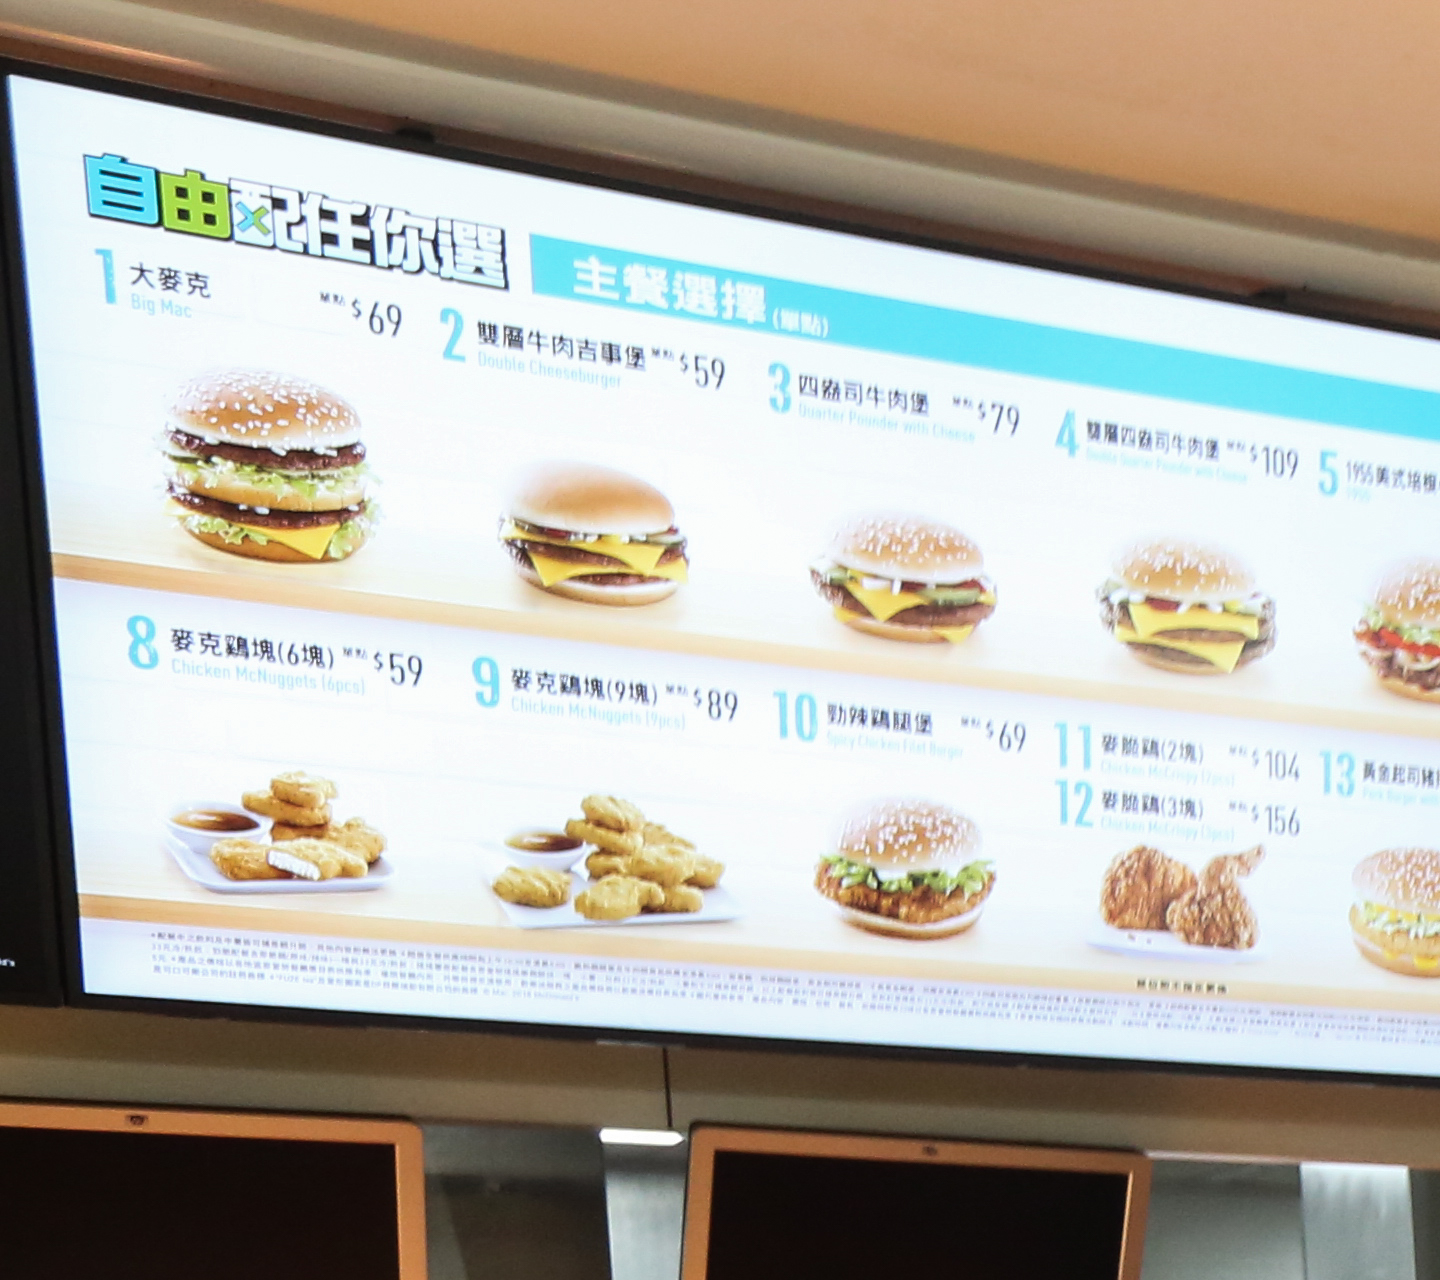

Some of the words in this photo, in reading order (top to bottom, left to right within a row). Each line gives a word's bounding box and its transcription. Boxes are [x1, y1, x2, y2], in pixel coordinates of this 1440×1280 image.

[95, 248, 117, 305] 1
[129, 262, 212, 300] 大麥克
[352, 298, 403, 340] $69
[130, 293, 157, 317] Big
[161, 299, 192, 319] Mac
[573, 255, 765, 325] 主餐選擇
[440, 307, 466, 363] 2
[477, 321, 646, 371] 雙層牛肉吉事堡
[680, 355, 726, 391] $59
[477, 351, 525, 375] Double
[529, 358, 622, 389] Cheeseburger
[768, 362, 791, 414] 3
[978, 402, 1020, 437] $79
[1055, 408, 1079, 458] 4
[1250, 444, 1298, 480] $109
[1319, 449, 1339, 497] 5
[126, 615, 159, 669] 8
[374, 651, 423, 688] $59
[171, 657, 230, 681] Chicken
[235, 666, 318, 694] McNuggets
[322, 677, 366, 697] (6pcs)
[471, 656, 500, 709] 9
[692, 687, 737, 723] $89
[511, 696, 564, 719] Chicken
[569, 704, 643, 730] McNuggets
[774, 690, 817, 743] 10
[986, 719, 1027, 753] $69
[1055, 722, 1092, 770] 11
[1250, 748, 1301, 782] $104
[1320, 750, 1356, 798] 13
[1055, 780, 1093, 828] 12
[1250, 803, 1301, 838] $156
